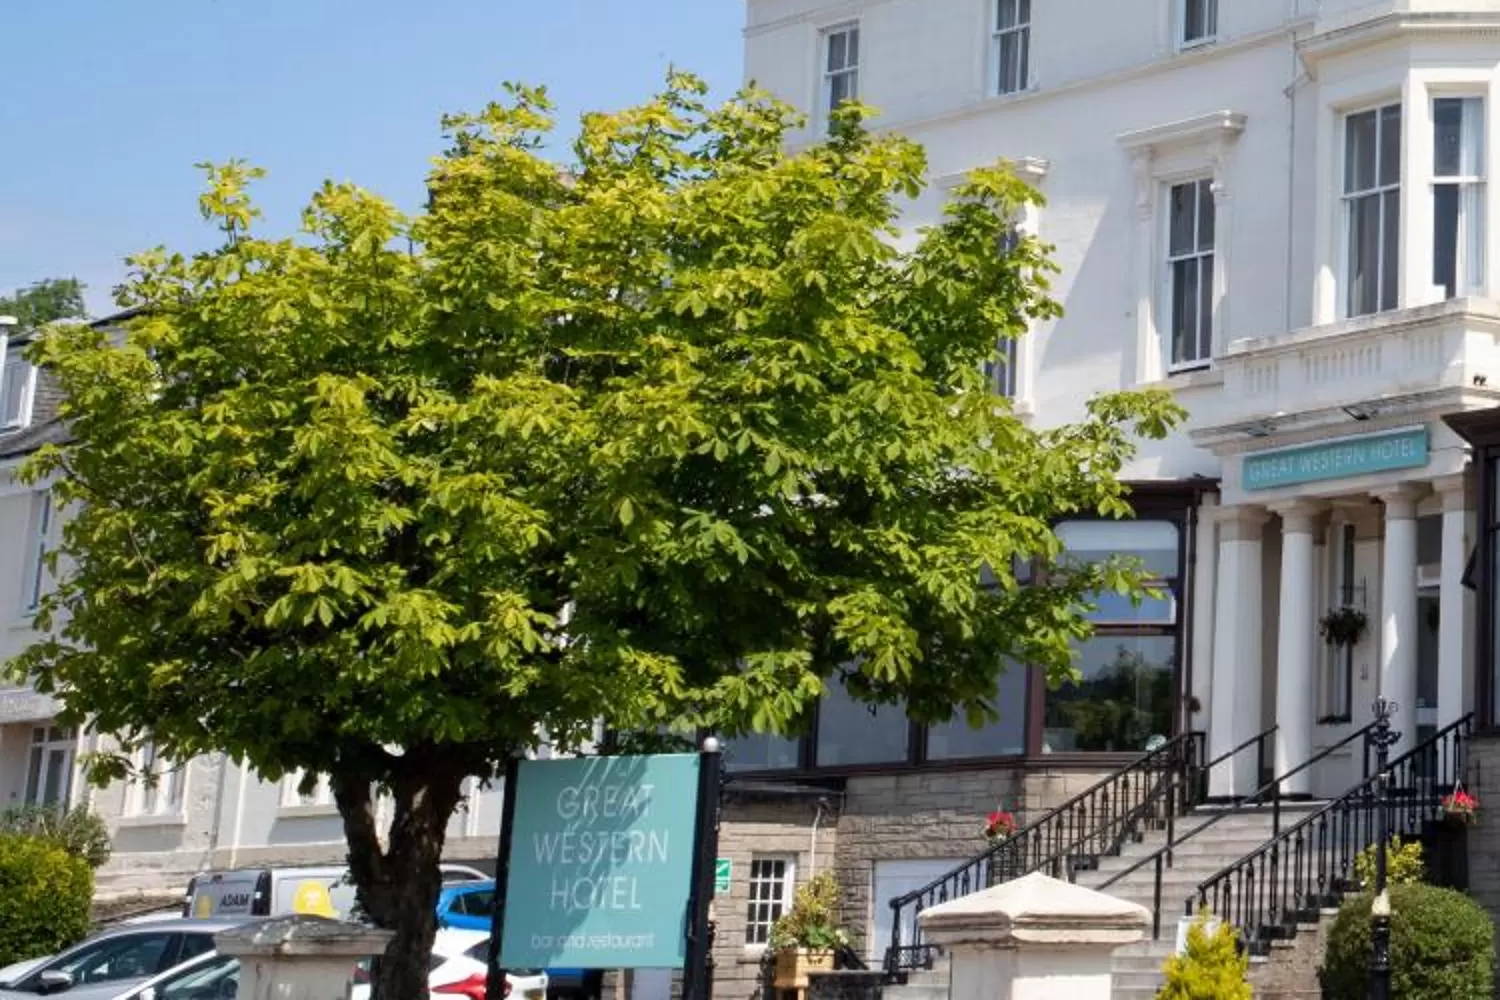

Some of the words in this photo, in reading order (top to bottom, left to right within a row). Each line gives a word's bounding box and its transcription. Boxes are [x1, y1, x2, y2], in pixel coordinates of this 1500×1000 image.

[1371, 438, 1414, 461] HOTEL
[556, 784, 655, 819] GREAT
[533, 829, 669, 864] WESTERN
[550, 876, 642, 909] HOTEL
